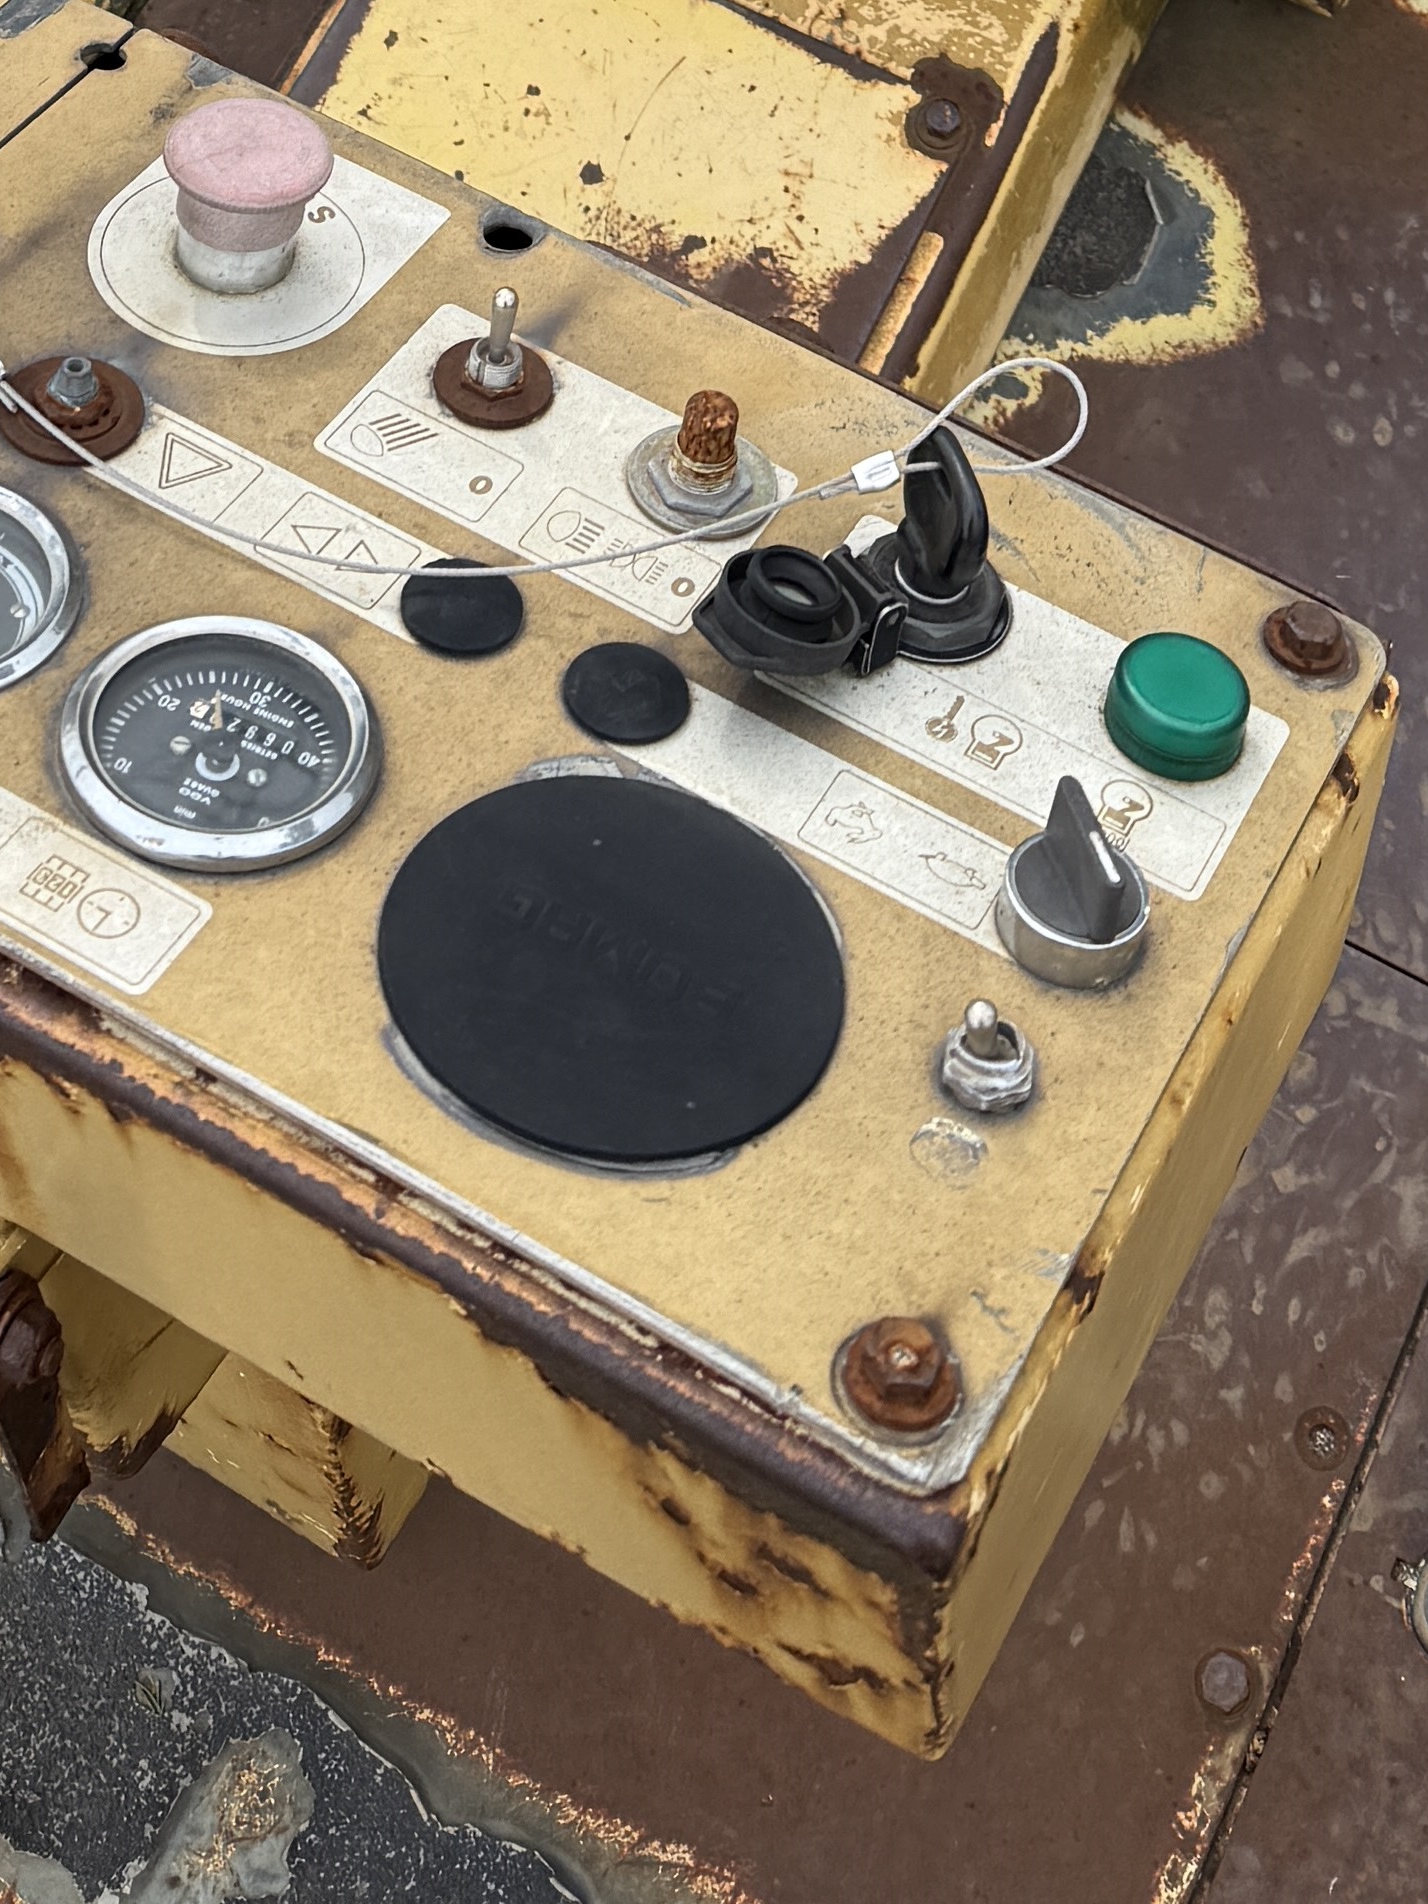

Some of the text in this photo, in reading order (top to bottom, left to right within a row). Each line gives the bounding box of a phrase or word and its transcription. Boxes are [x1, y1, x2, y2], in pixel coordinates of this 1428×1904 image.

[157, 694, 181, 712] 20
[249, 691, 272, 708] 30
[253, 706, 295, 729] ENGINE
[113, 756, 134, 774] 10
[297, 751, 321, 768] 40
[178, 786, 212, 806] VDO
